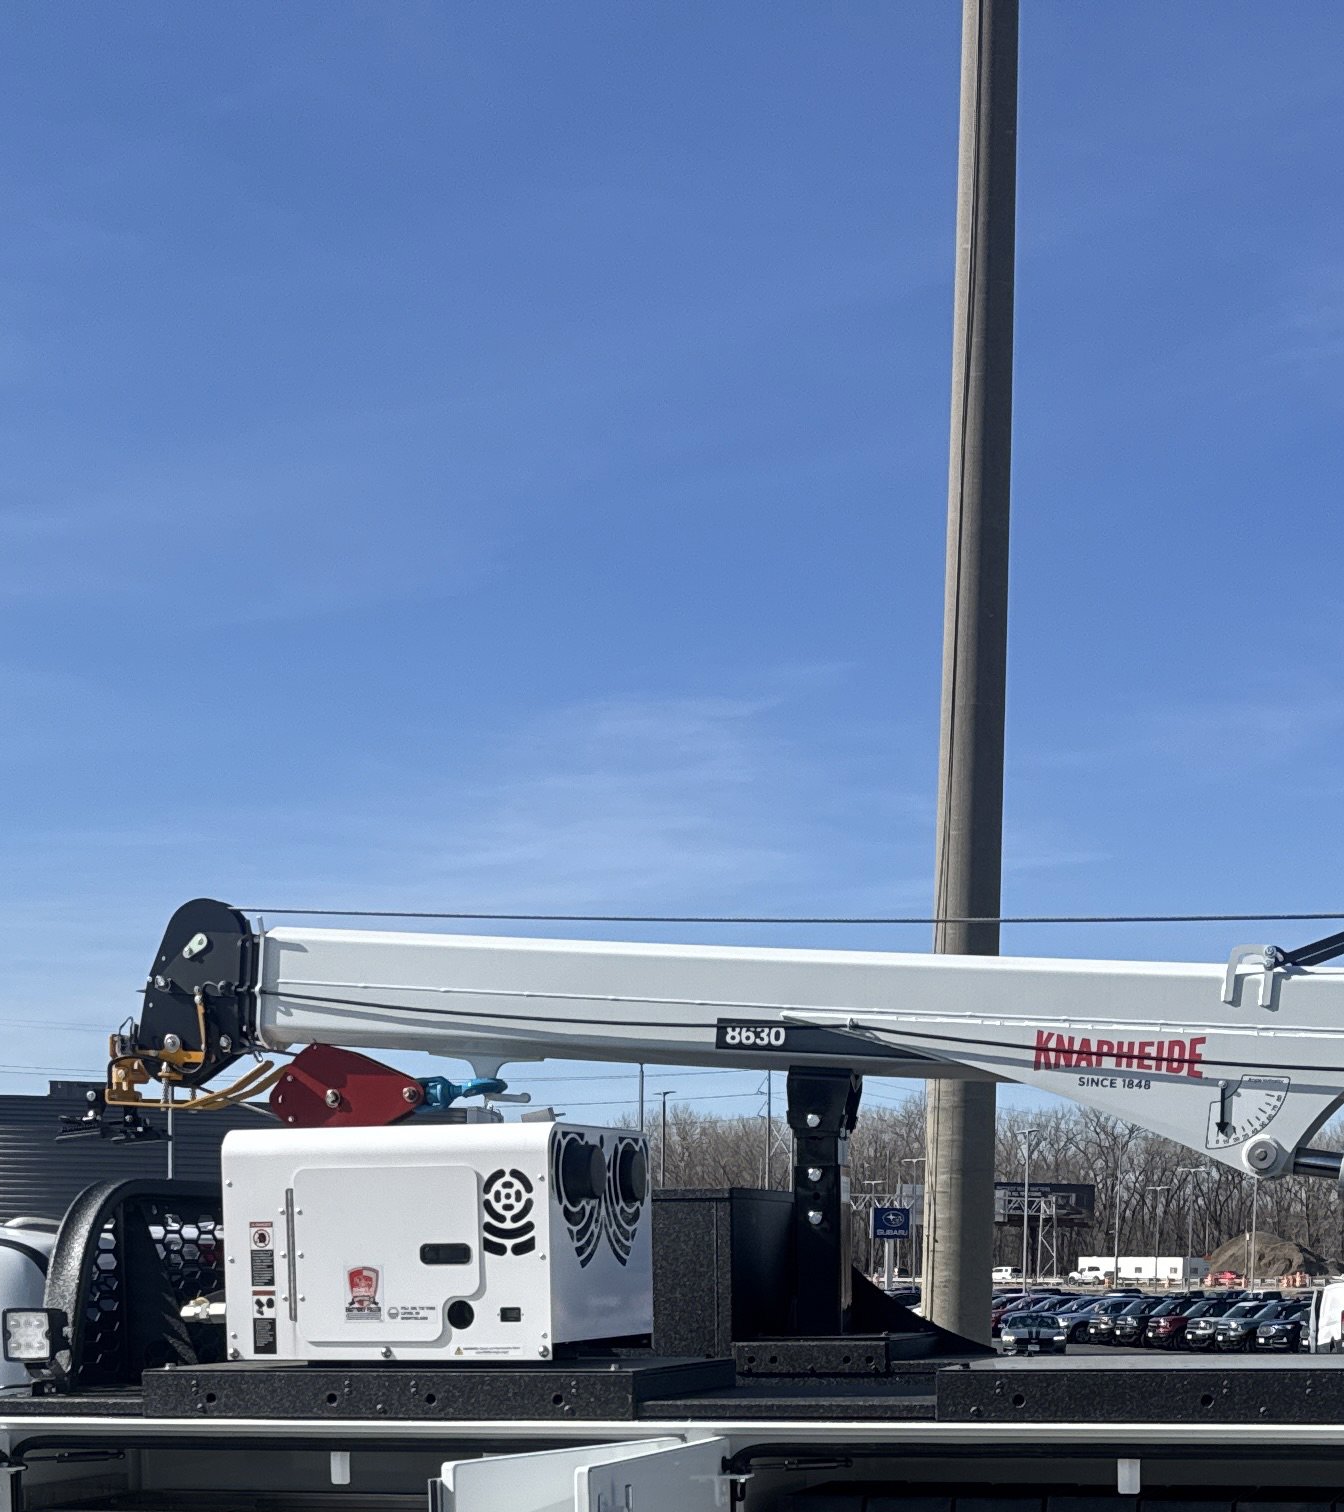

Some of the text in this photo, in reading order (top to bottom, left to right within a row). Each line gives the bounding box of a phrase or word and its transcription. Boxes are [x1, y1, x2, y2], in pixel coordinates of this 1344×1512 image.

[725, 1027, 786, 1047] 8630
[1033, 1029, 1207, 1079] KNAPHEIDE
[1078, 1076, 1152, 1090] SINCE 1848
